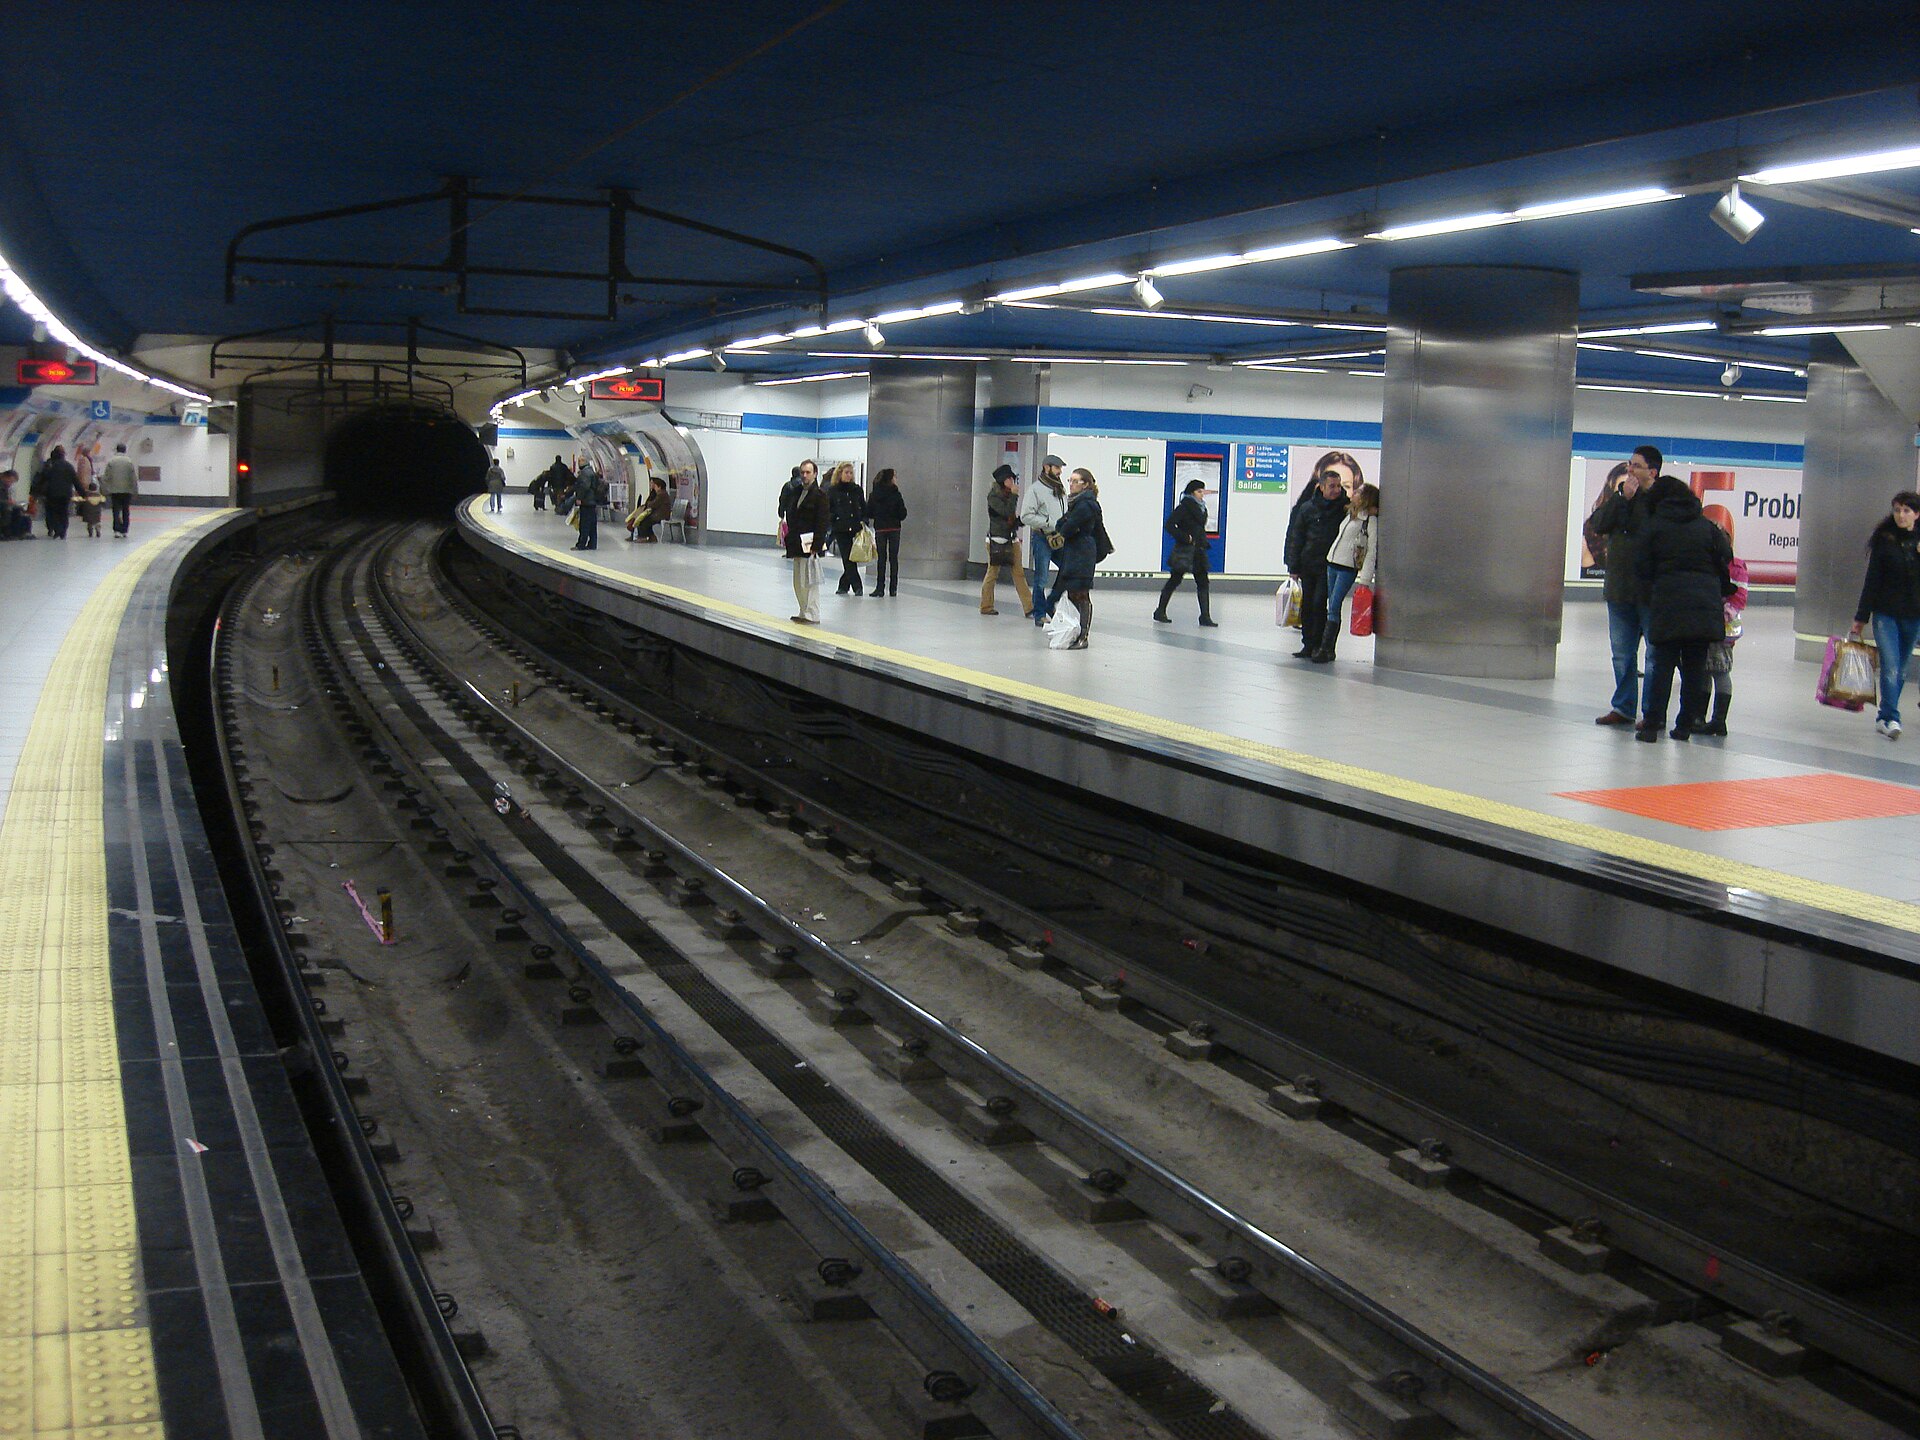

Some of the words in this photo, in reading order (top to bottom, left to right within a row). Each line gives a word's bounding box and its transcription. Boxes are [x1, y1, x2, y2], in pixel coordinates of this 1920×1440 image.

[1247, 446, 1254, 455] 2
[1247, 458, 1254, 466] 3
[1237, 481, 1262, 490] Salida
